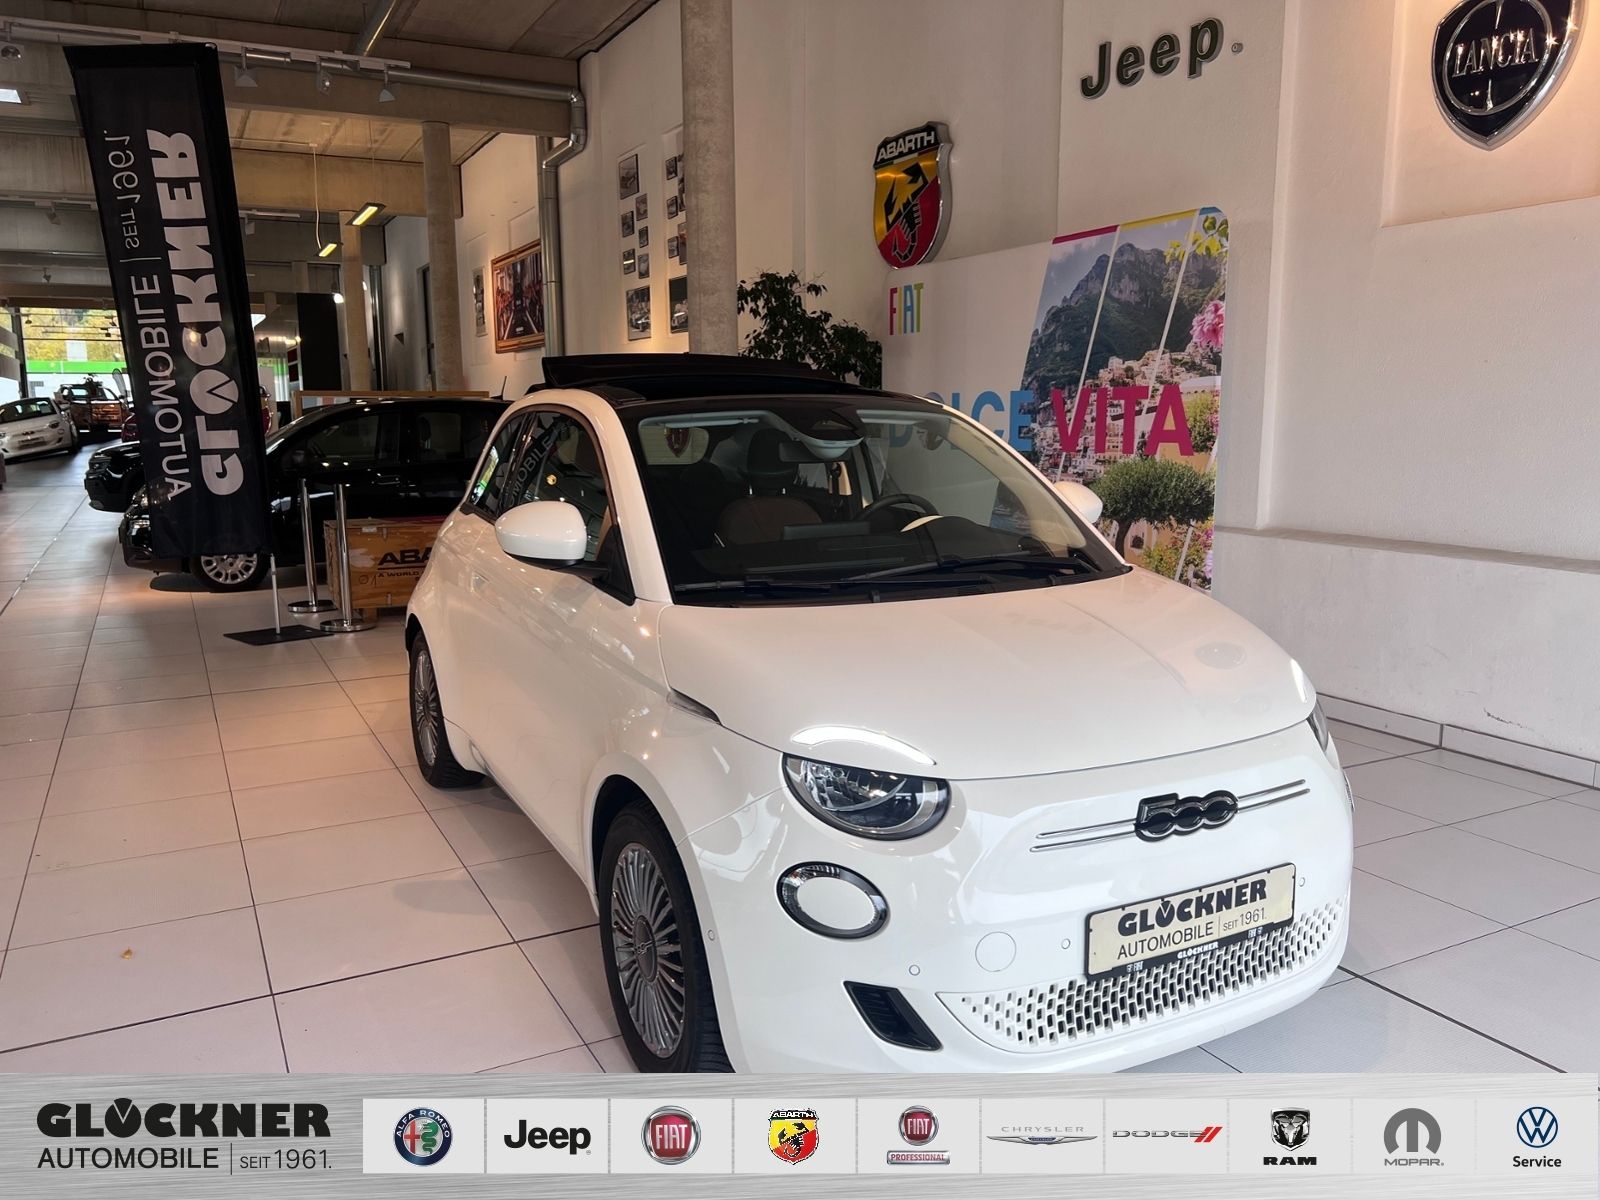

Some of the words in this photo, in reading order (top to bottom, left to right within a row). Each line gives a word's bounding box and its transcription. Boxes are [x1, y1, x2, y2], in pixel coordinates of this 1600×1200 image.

[1080, 17, 1224, 99] Jeep
[1452, 28, 1539, 78] LANCIA
[877, 131, 935, 163] ABARTH
[889, 282, 924, 335] FIAT
[1051, 384, 1194, 456] VITA
[1134, 789, 1238, 842] 500
[1117, 921, 1214, 960] AUTOMOBILE
[1223, 919, 1239, 932] SEIT
